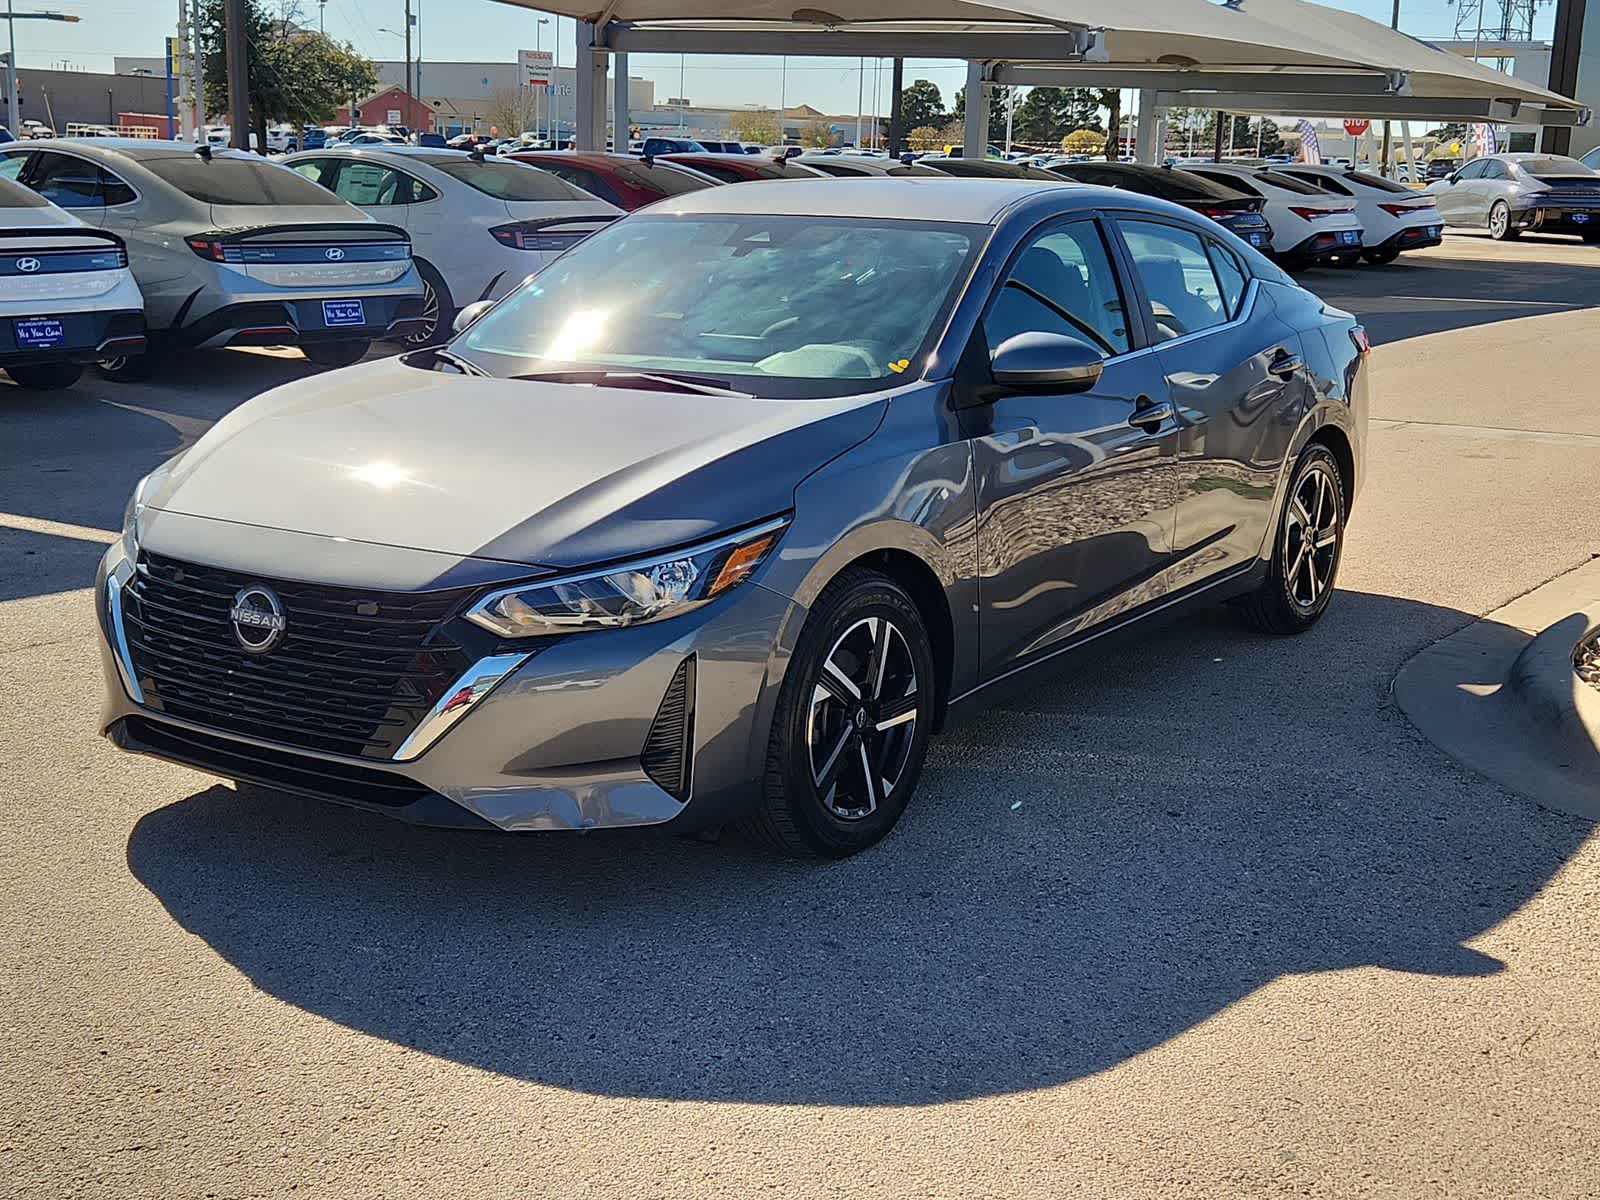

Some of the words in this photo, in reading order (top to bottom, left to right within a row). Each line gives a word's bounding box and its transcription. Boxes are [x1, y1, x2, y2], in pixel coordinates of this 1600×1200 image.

[1344, 118, 1365, 126] STOP
[31, 328, 44, 337] You
[231, 608, 282, 628] NISSAN
